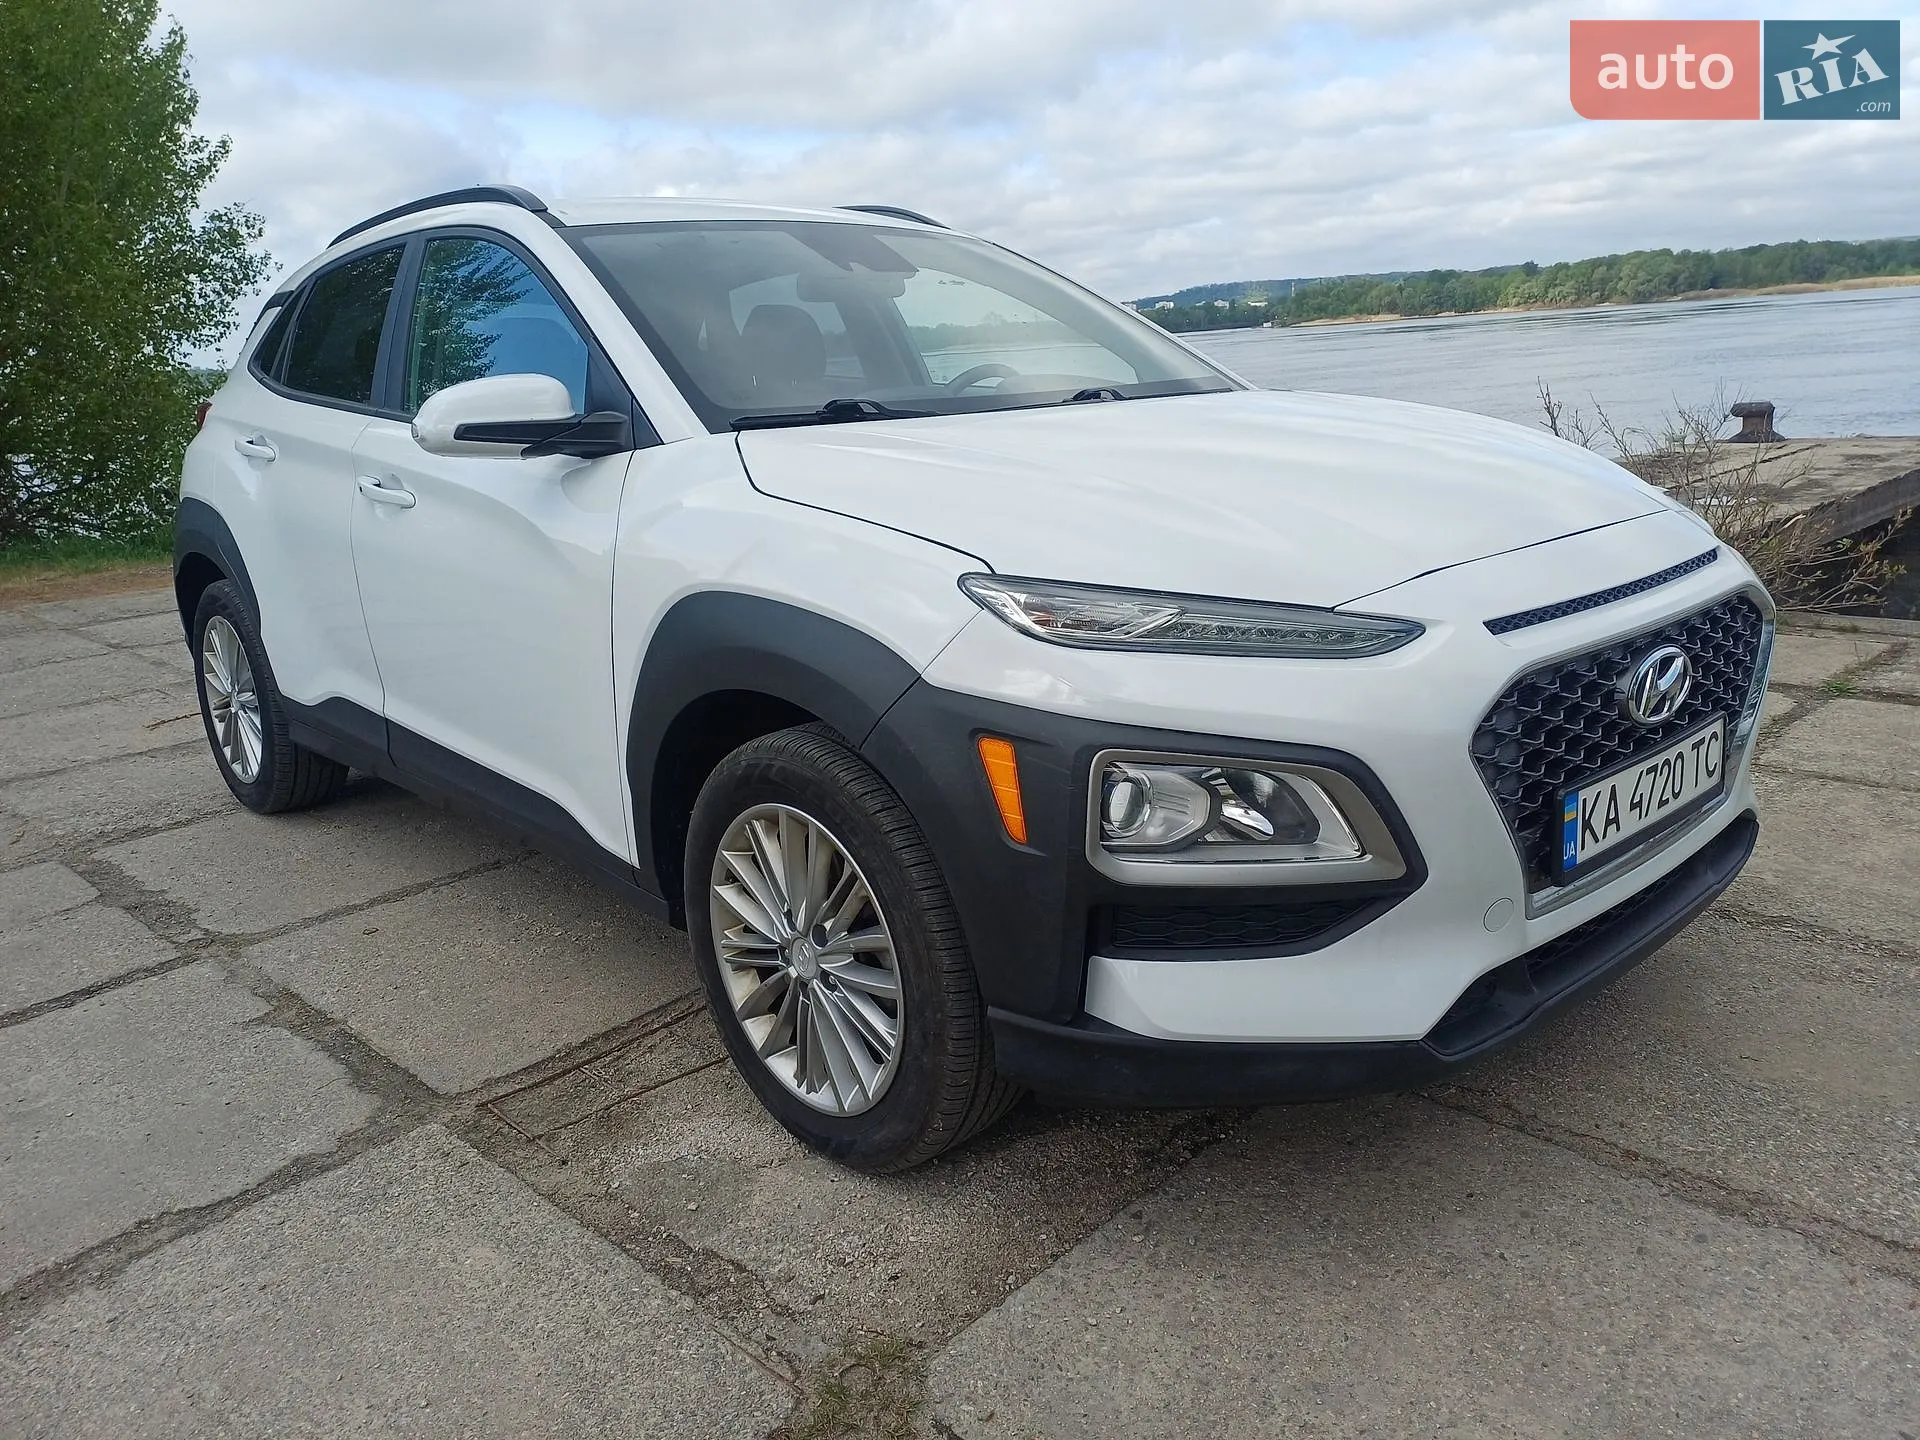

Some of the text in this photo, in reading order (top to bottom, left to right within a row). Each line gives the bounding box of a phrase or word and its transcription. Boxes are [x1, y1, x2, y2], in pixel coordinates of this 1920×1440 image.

[1581, 731, 1719, 850] KA 4720 TC
[1564, 841, 1575, 859] UA
